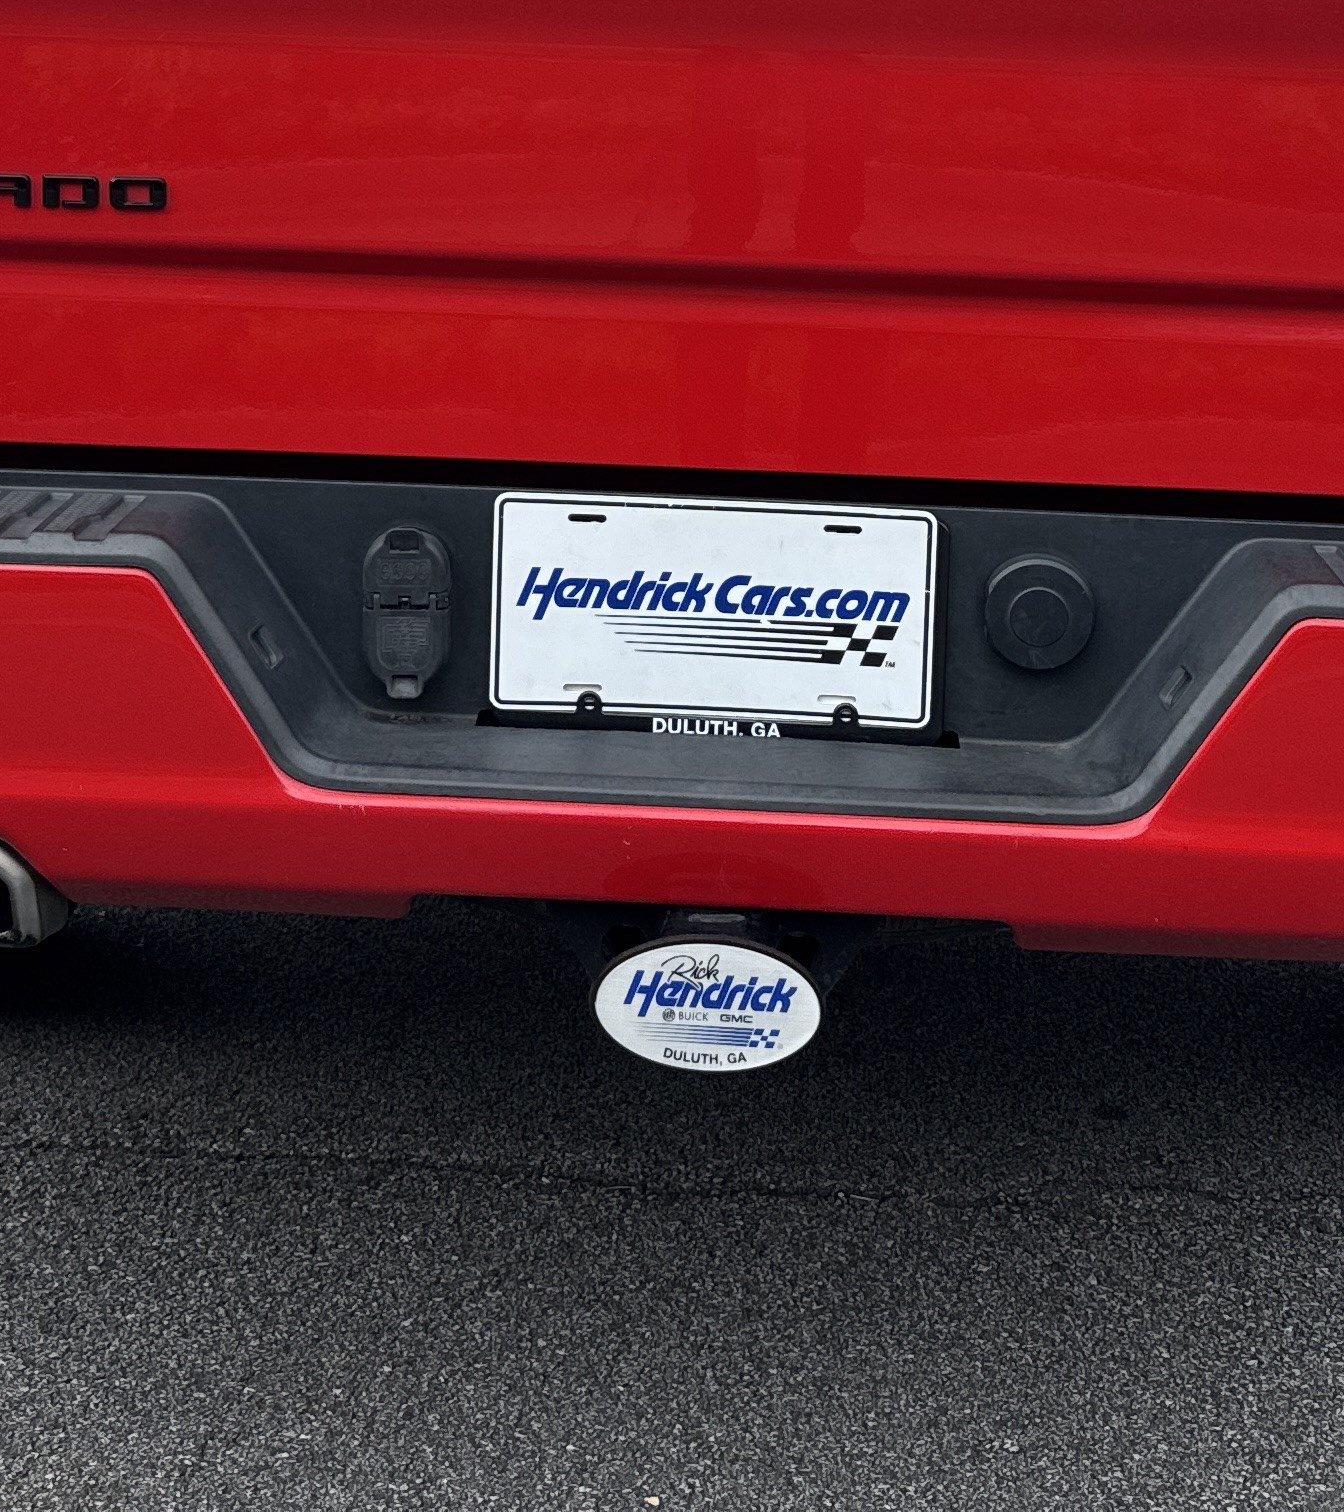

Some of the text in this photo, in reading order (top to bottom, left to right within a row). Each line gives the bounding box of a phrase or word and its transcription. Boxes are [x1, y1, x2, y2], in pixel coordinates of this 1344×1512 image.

[750, 722, 781, 738] GA
[661, 953, 720, 989] Rick
[623, 969, 798, 1017] Hendrick
[678, 1011, 754, 1024] BUICK GMC
[662, 1047, 747, 1066] DULUTH, GA
